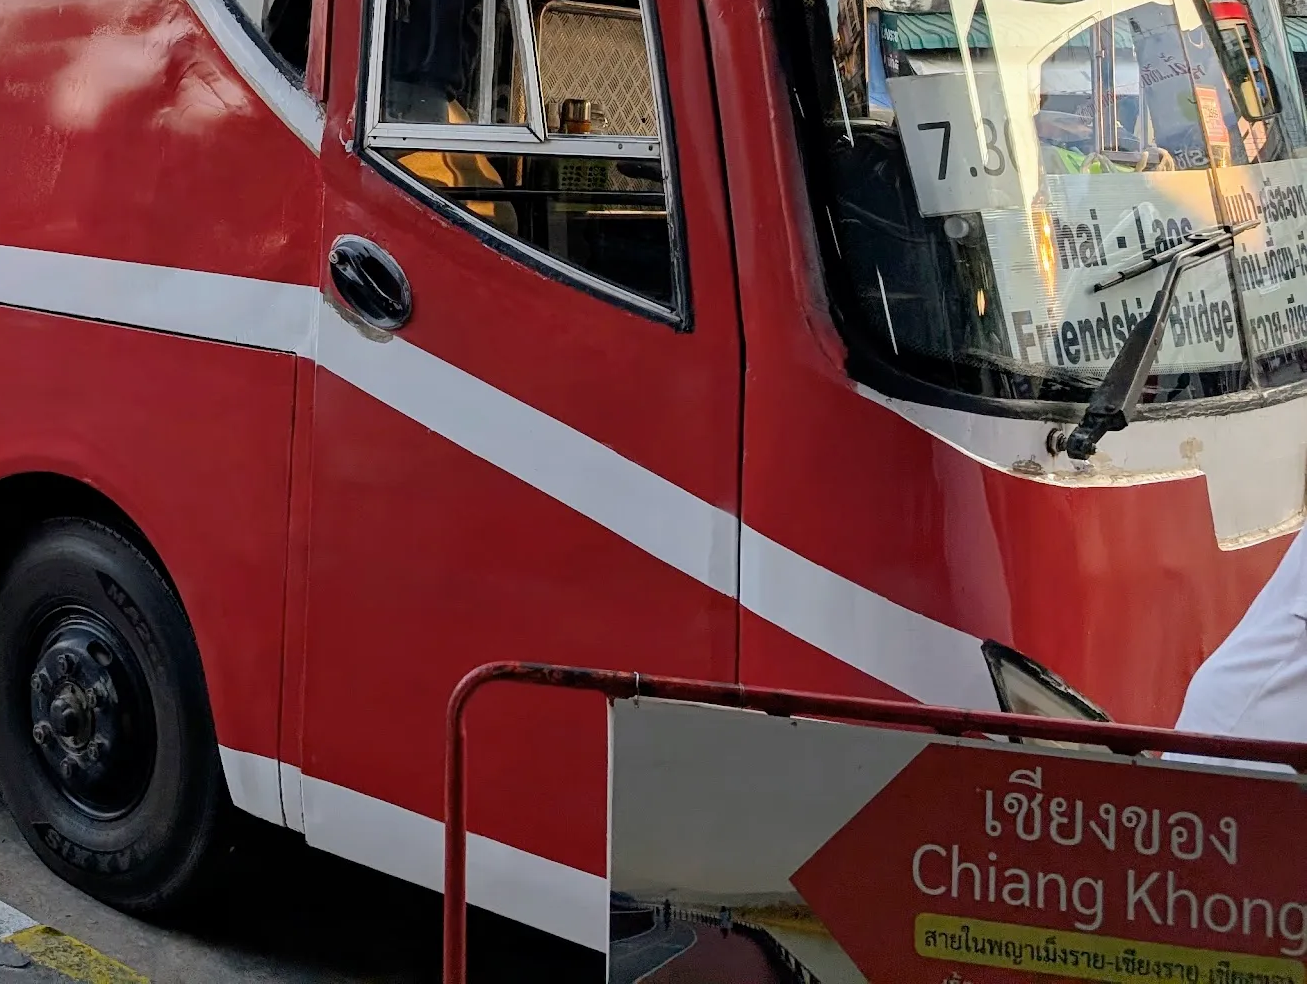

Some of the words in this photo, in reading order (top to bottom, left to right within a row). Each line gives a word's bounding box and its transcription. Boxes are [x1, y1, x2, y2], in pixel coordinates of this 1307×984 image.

[1053, 208, 1108, 270] hai
[1168, 290, 1234, 353] Bridge
[984, 766, 1239, 864] เชียงของ
[912, 844, 1105, 930] Chiang
[1126, 869, 1307, 956] Khong
